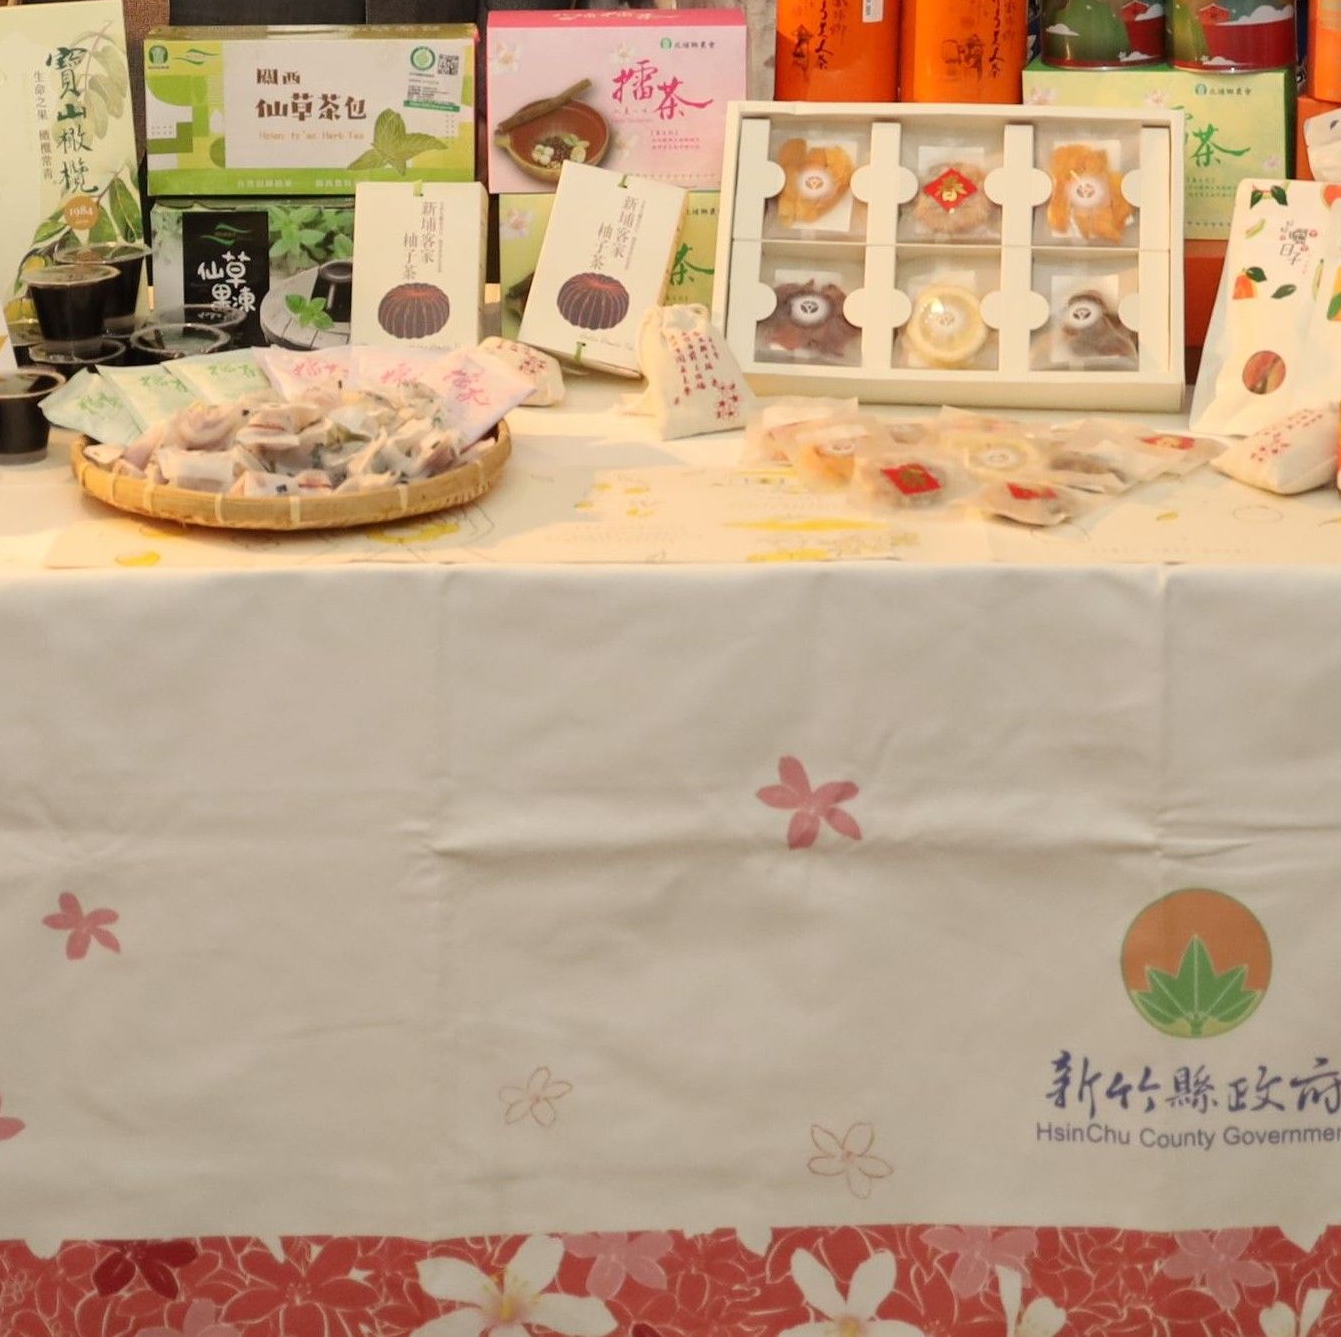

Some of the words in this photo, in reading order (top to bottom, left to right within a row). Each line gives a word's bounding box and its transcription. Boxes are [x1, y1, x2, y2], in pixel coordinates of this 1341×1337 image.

[255, 92, 367, 121] 仙草茶包
[612, 59, 713, 120] 擂茶
[197, 251, 251, 288] 仙草
[403, 231, 418, 281] 柚子茶
[1035, 1121, 1131, 1146] HsinChu
[1139, 1127, 1215, 1151] County
